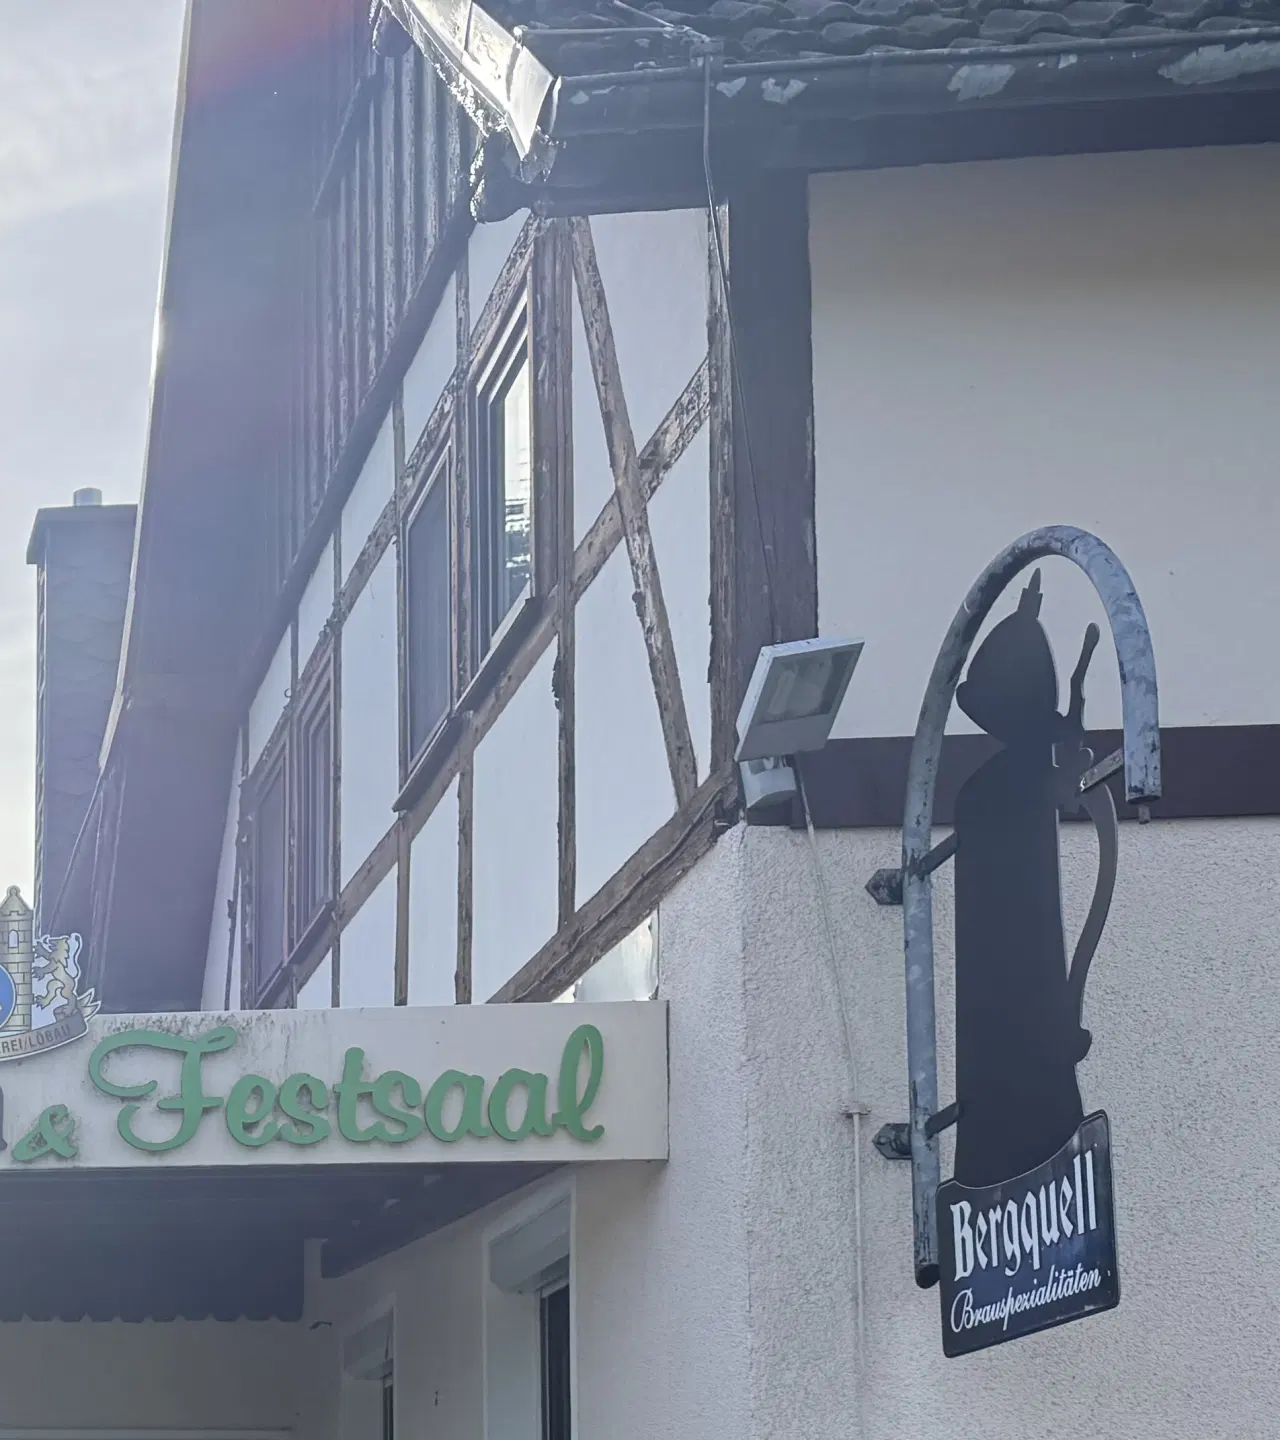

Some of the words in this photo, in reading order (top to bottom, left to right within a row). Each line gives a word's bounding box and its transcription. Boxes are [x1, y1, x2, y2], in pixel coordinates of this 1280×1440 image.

[12, 1103, 78, 1164] &
[88, 1023, 605, 1152] Festsaal
[950, 1149, 1097, 1281] Bergquell
[950, 1261, 1102, 1333] Brauspezialitäten
